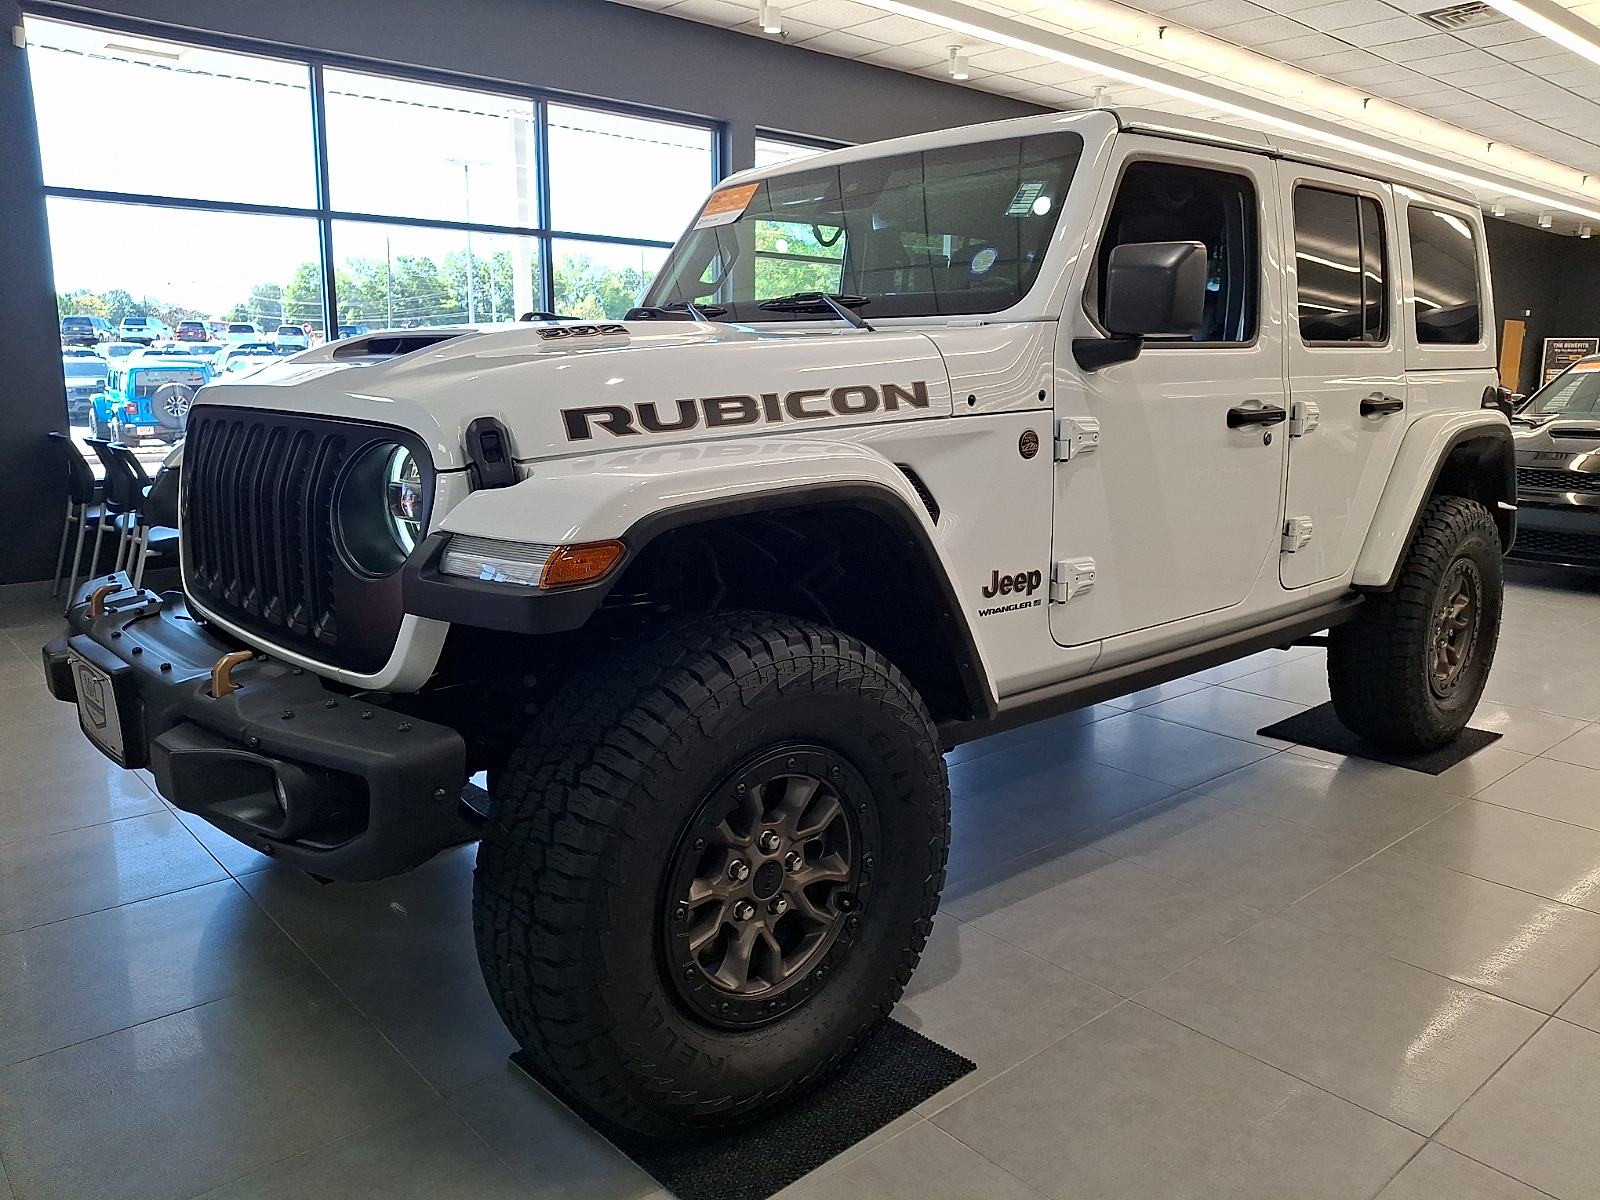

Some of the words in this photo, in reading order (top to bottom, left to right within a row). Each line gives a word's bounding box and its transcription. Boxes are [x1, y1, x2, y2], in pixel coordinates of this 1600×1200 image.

[559, 380, 931, 442] RUBICON
[981, 569, 1042, 599] Jeep
[978, 601, 1032, 617] WRANGLER
